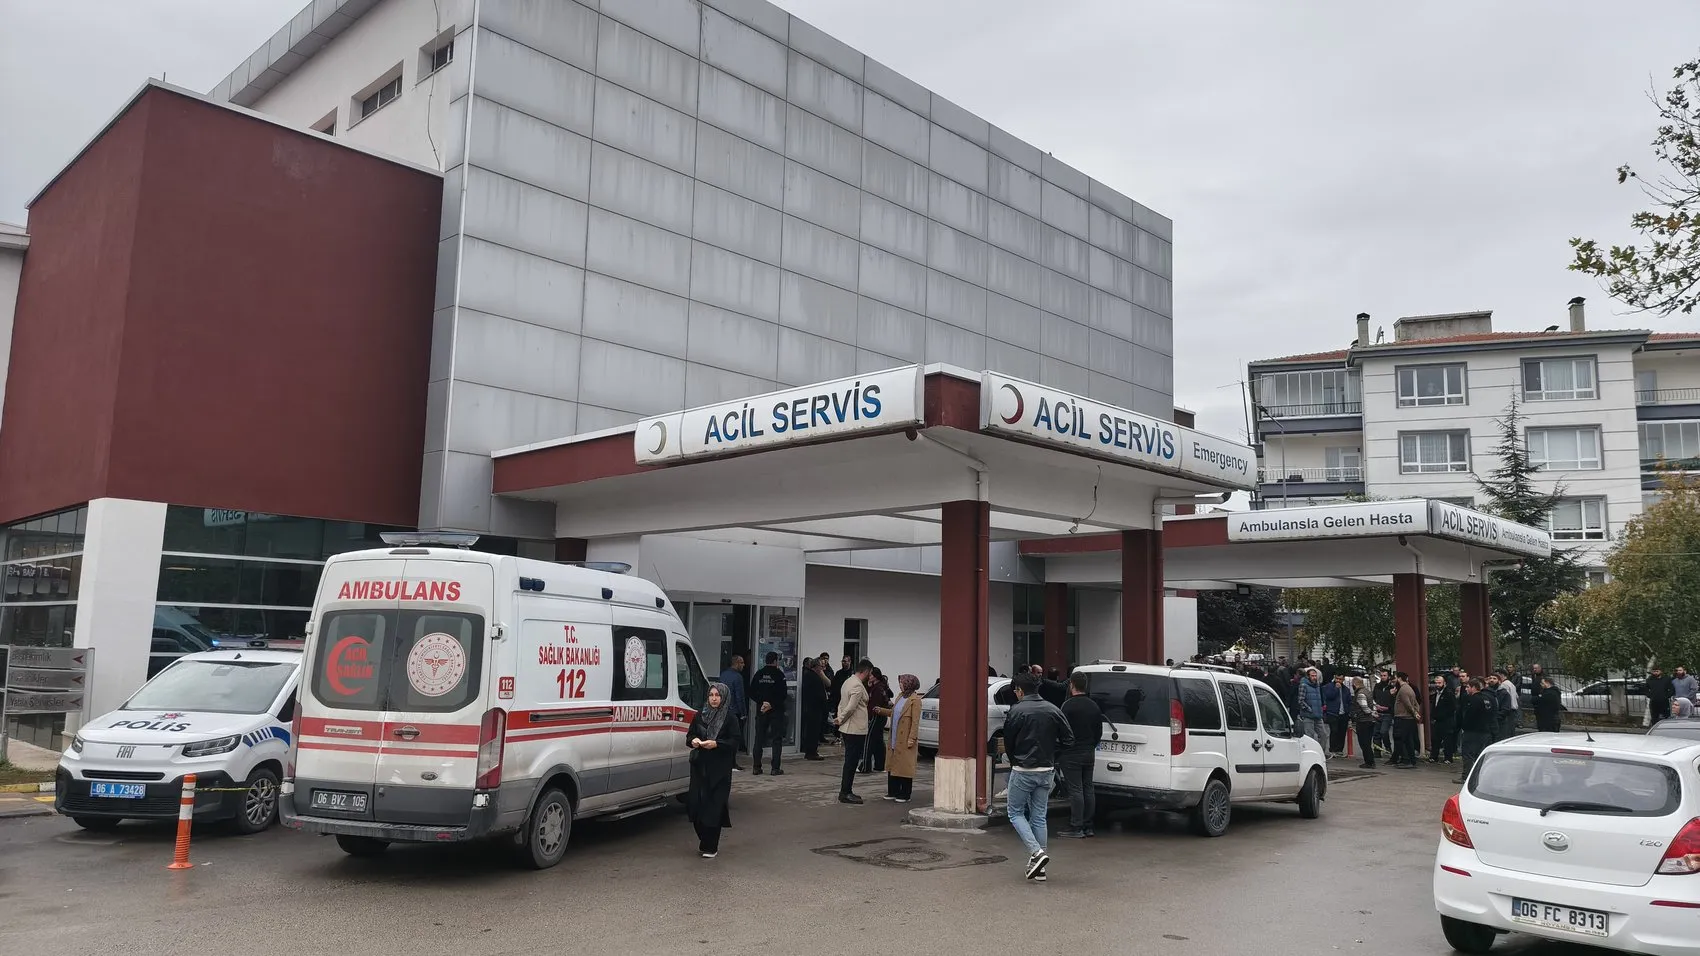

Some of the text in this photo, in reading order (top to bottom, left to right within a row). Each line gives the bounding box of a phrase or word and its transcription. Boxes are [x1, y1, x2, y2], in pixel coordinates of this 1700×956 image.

[704, 381, 882, 445] ACİL SERVİS
[1033, 397, 1175, 460] ACİL SERVİS
[1193, 441, 1248, 475] Emergency
[1239, 513, 1413, 533] Ambulansla Gelen Hasta
[1441, 508, 1498, 540] ACİL SERVİS
[338, 581, 461, 601] AMBULANS
[564, 625, 578, 643] T.C.
[538, 643, 600, 666] SAĞLIK BAKANLIĞI
[501, 679, 513, 690] 112
[556, 669, 586, 698] 112
[613, 706, 663, 722] AMBULANS
[108, 720, 192, 732] POLİS
[116, 745, 136, 759] FIAT
[1121, 744, 1137, 753] 9239
[96, 783, 144, 795] 06 A 73428
[317, 793, 366, 807] 06 BVZ 105
[1521, 902, 1538, 919] 06
[1544, 906, 1561, 922] FC
[1568, 910, 1605, 930] 8313
